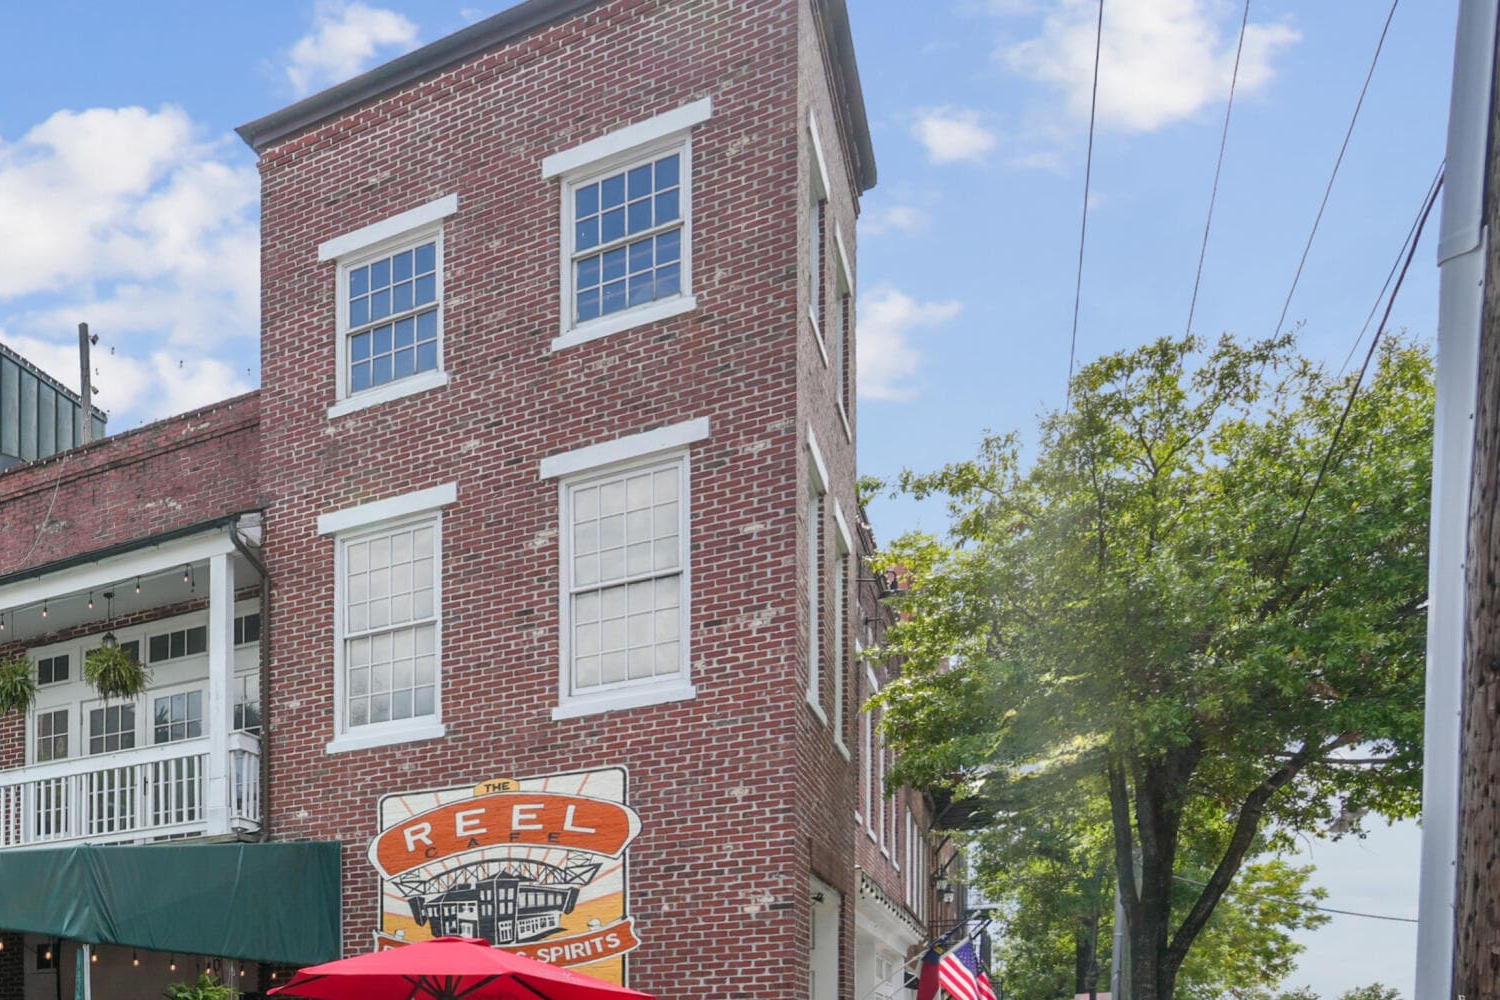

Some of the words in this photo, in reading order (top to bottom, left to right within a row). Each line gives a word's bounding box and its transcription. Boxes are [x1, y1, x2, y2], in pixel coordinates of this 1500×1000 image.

[484, 782, 510, 792] THE
[403, 803, 596, 852] REEL
[425, 832, 561, 858] CAFE
[536, 932, 621, 964] SPIRITS
